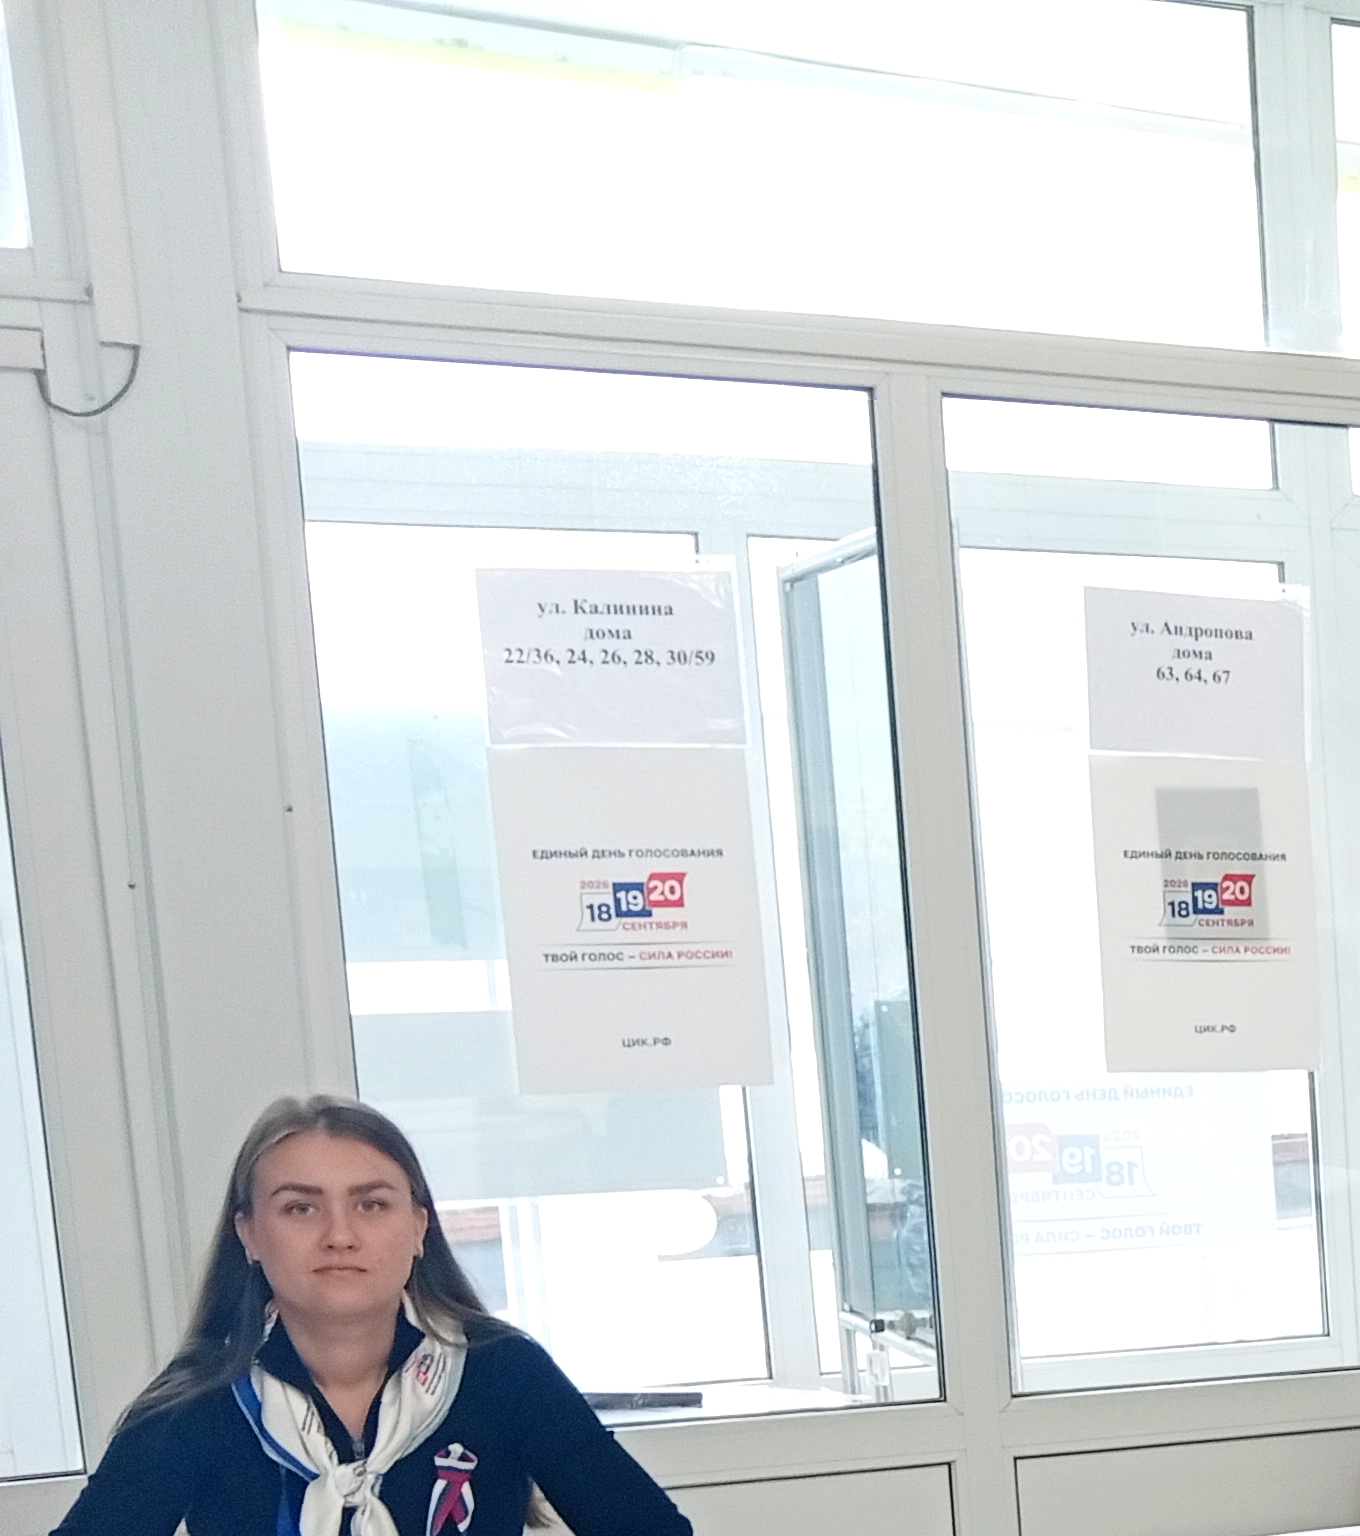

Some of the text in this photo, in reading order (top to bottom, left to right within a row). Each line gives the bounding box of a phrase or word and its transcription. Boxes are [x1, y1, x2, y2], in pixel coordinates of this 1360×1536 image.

[537, 598, 674, 617] ул. Калинина
[583, 628, 632, 641] дома
[1131, 621, 1253, 641] ул. Андропова
[504, 648, 715, 667] 22/36, 24, 26, 28, 30/59
[1172, 648, 1213, 661] дома
[1156, 666, 1230, 685] 63, 64, 67
[533, 847, 723, 860] ЕДИНЫЙ ДЕНЬ ГОЛОСОВАНИЯ
[1123, 849, 1287, 861] ЕДИНЫЙ ДЕНЬ ГОЛОСОВАНИЯ
[586, 879, 681, 922] 18 19 20
[1168, 881, 1249, 918] 18 19 20
[622, 921, 688, 931] СЕНТЯБРЯ
[1198, 919, 1254, 927] СЕНТЯБРЯ
[1130, 944, 1290, 955] ТВОЙ ГОЛОС СИЛА РОССИИ!
[543, 950, 733, 963] ТВОЙ ГОЛОС СИЛА РОССИИ!
[1195, 1025, 1236, 1034] ЦИК.РФ
[622, 1037, 672, 1048] ЦИК.РФ
